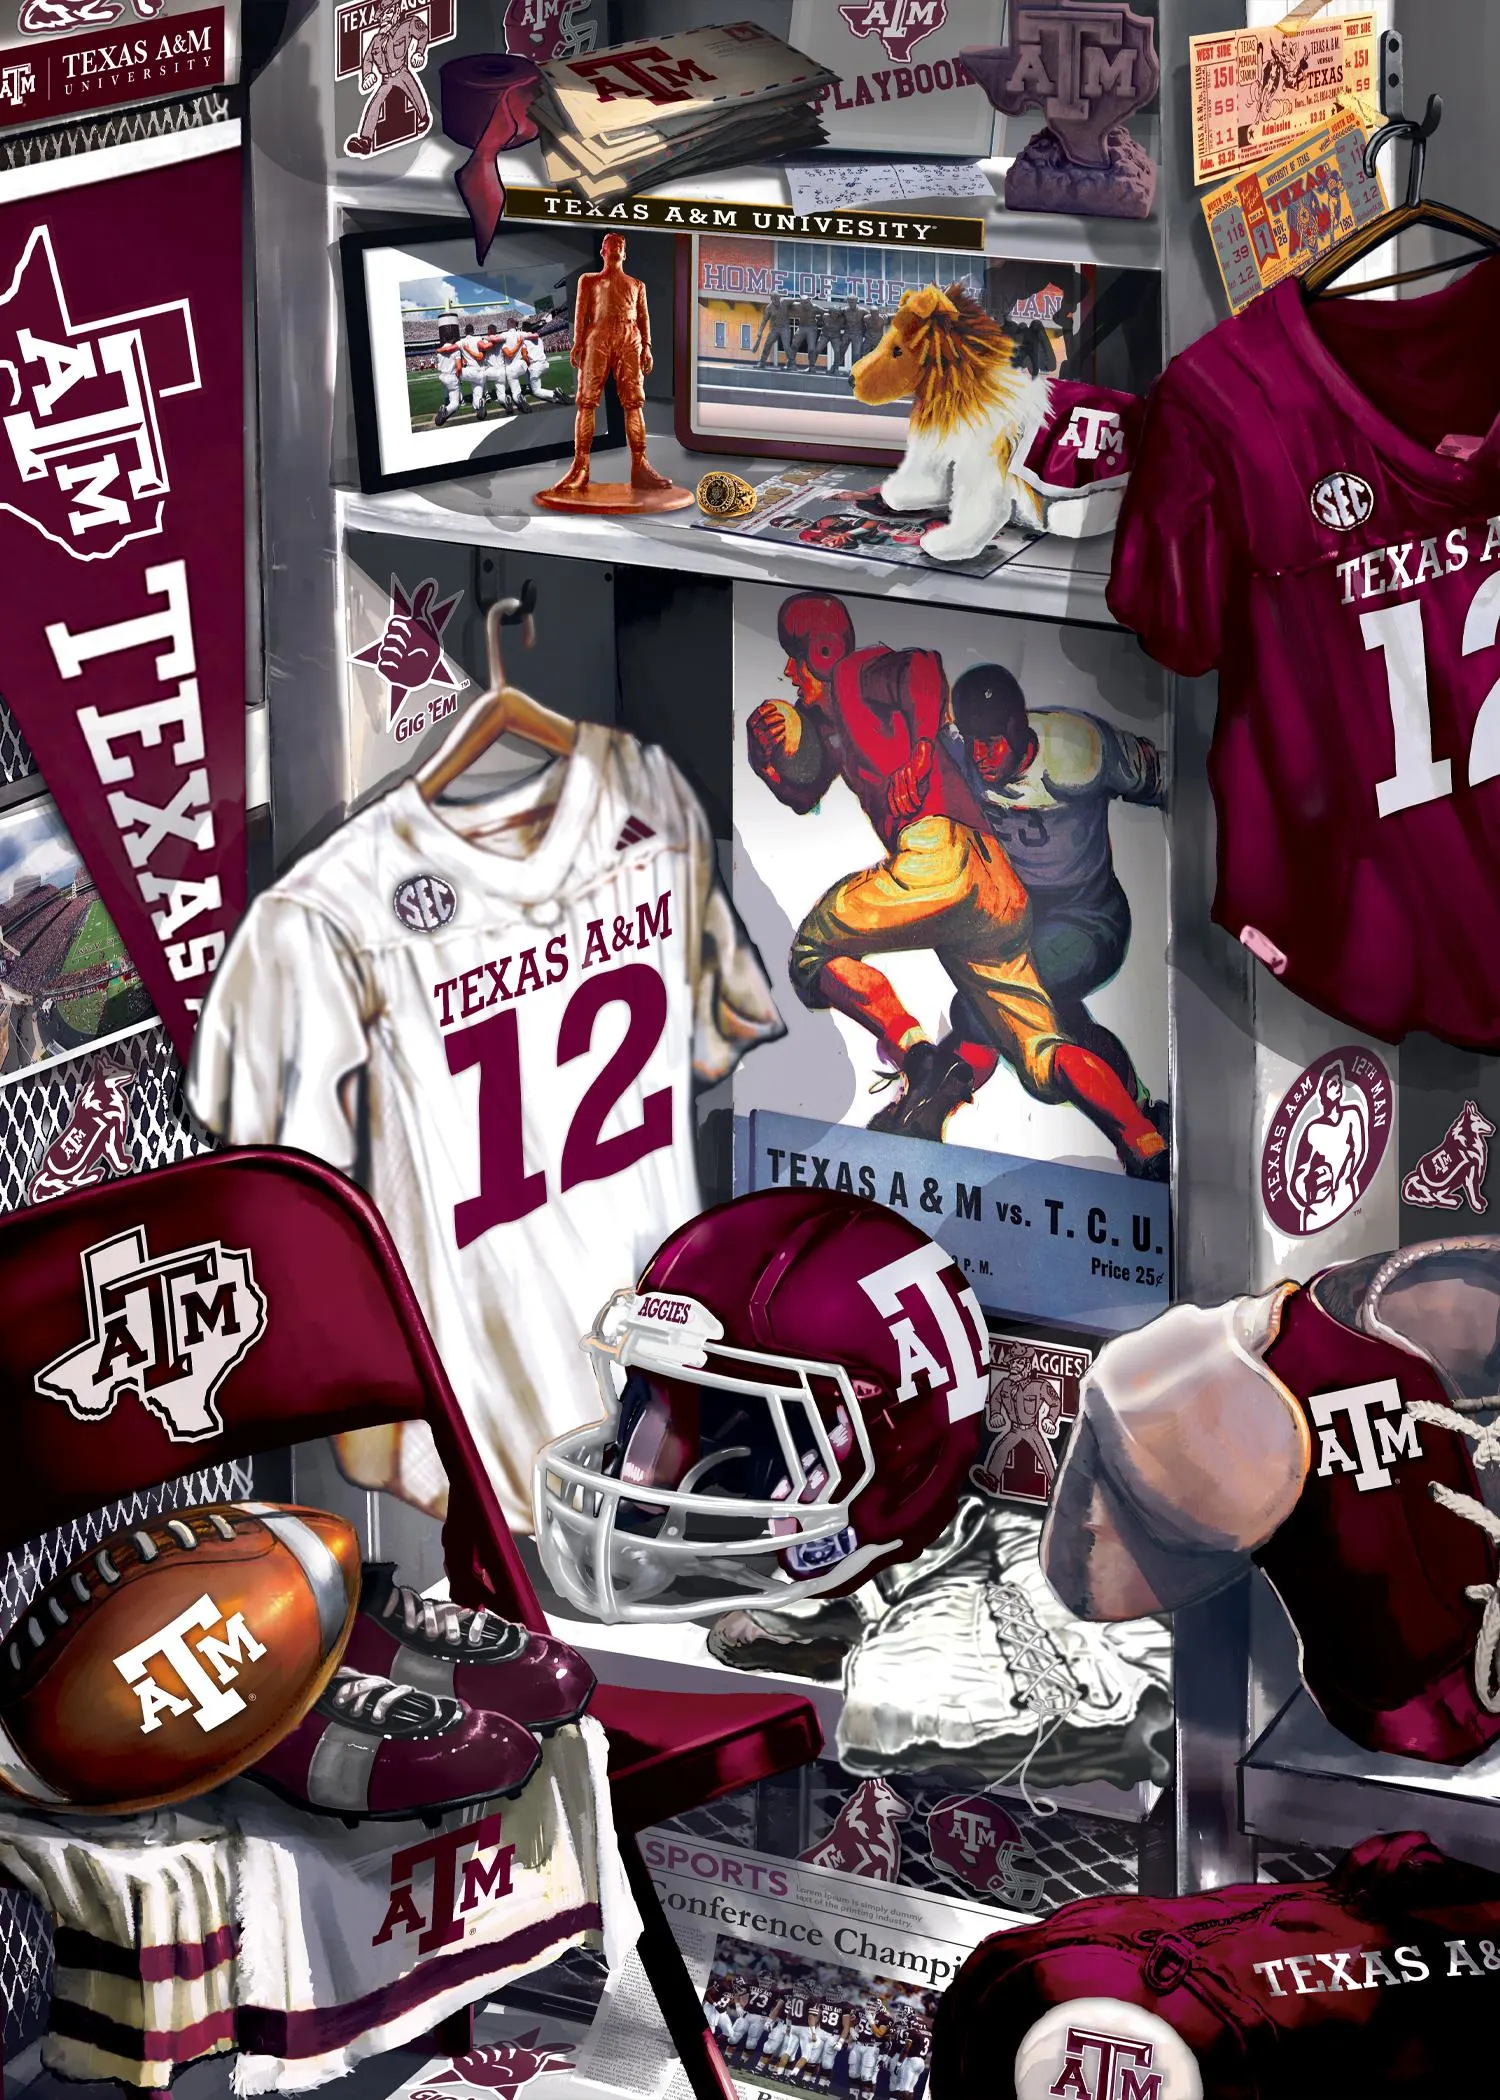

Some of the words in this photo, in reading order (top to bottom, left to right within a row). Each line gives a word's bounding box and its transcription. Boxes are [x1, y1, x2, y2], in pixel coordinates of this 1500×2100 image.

[342, 8, 377, 33] TEXA
[1346, 24, 1359, 36] WEST
[62, 40, 148, 79] TEXAS
[155, 26, 212, 61] A&M
[1196, 46, 1214, 62] WEST
[1217, 43, 1232, 59] SIDE
[1240, 40, 1256, 54] TEXAS
[1311, 40, 1325, 55] TEXAS
[65, 56, 212, 96] UNIVERSITY
[1307, 65, 1344, 89] TEXAS
[1356, 78, 1370, 92] 59
[1215, 98, 1234, 116] 59
[1216, 127, 1234, 145] 11
[1262, 120, 1291, 137] Admission
[1200, 157, 1214, 171] Adm.
[1218, 150, 1236, 166] $3.25
[1265, 164, 1326, 216] TEXAS
[545, 197, 649, 222] TEXAS
[665, 206, 738, 228] A&M
[753, 212, 934, 242] UNIVESITY
[1227, 222, 1245, 245] 118
[1277, 234, 1288, 248] 28
[1232, 244, 1250, 264] 39
[704, 264, 788, 297] HOME
[799, 274, 839, 300] OF
[1238, 265, 1255, 285] 12
[1315, 476, 1371, 528] SEC
[1336, 527, 1469, 605] TEXAS
[394, 715, 425, 744] GIG
[45, 559, 226, 983] TEXAS
[398, 877, 455, 929] SEC
[434, 933, 569, 1028] TEXAS
[581, 889, 672, 970] A&M
[1351, 1056, 1377, 1080] 12TH
[1370, 1079, 1387, 1128] MAN
[443, 962, 673, 1250] 12
[1267, 1124, 1287, 1202] TEXAS
[1284, 1075, 1313, 1118] A&M
[767, 1147, 877, 1201] TEXAS
[889, 1171, 909, 1209] A
[919, 1177, 944, 1216] &
[956, 1182, 982, 1222] M
[1045, 1199, 1075, 1240] T.
[1087, 1206, 1120, 1248] C.
[1132, 1214, 1164, 1255] U.
[1091, 1257, 1130, 1282] Price
[638, 1297, 691, 1325] AGGIES
[1031, 1352, 1083, 1379] AGGIES
[645, 1841, 789, 1897] SPORTS
[651, 1879, 823, 1946] Conference
[796, 1885, 822, 1898] Lorem
[860, 1901, 889, 1914] simply
[890, 1908, 923, 1922] dummy
[825, 1900, 839, 1910] the
[840, 1903, 874, 1920] printing
[1255, 1945, 1431, 2000] TEXAS
[1443, 1940, 1500, 1977] A&
[749, 1991, 769, 2009] 73
[821, 2010, 840, 2027] 68
